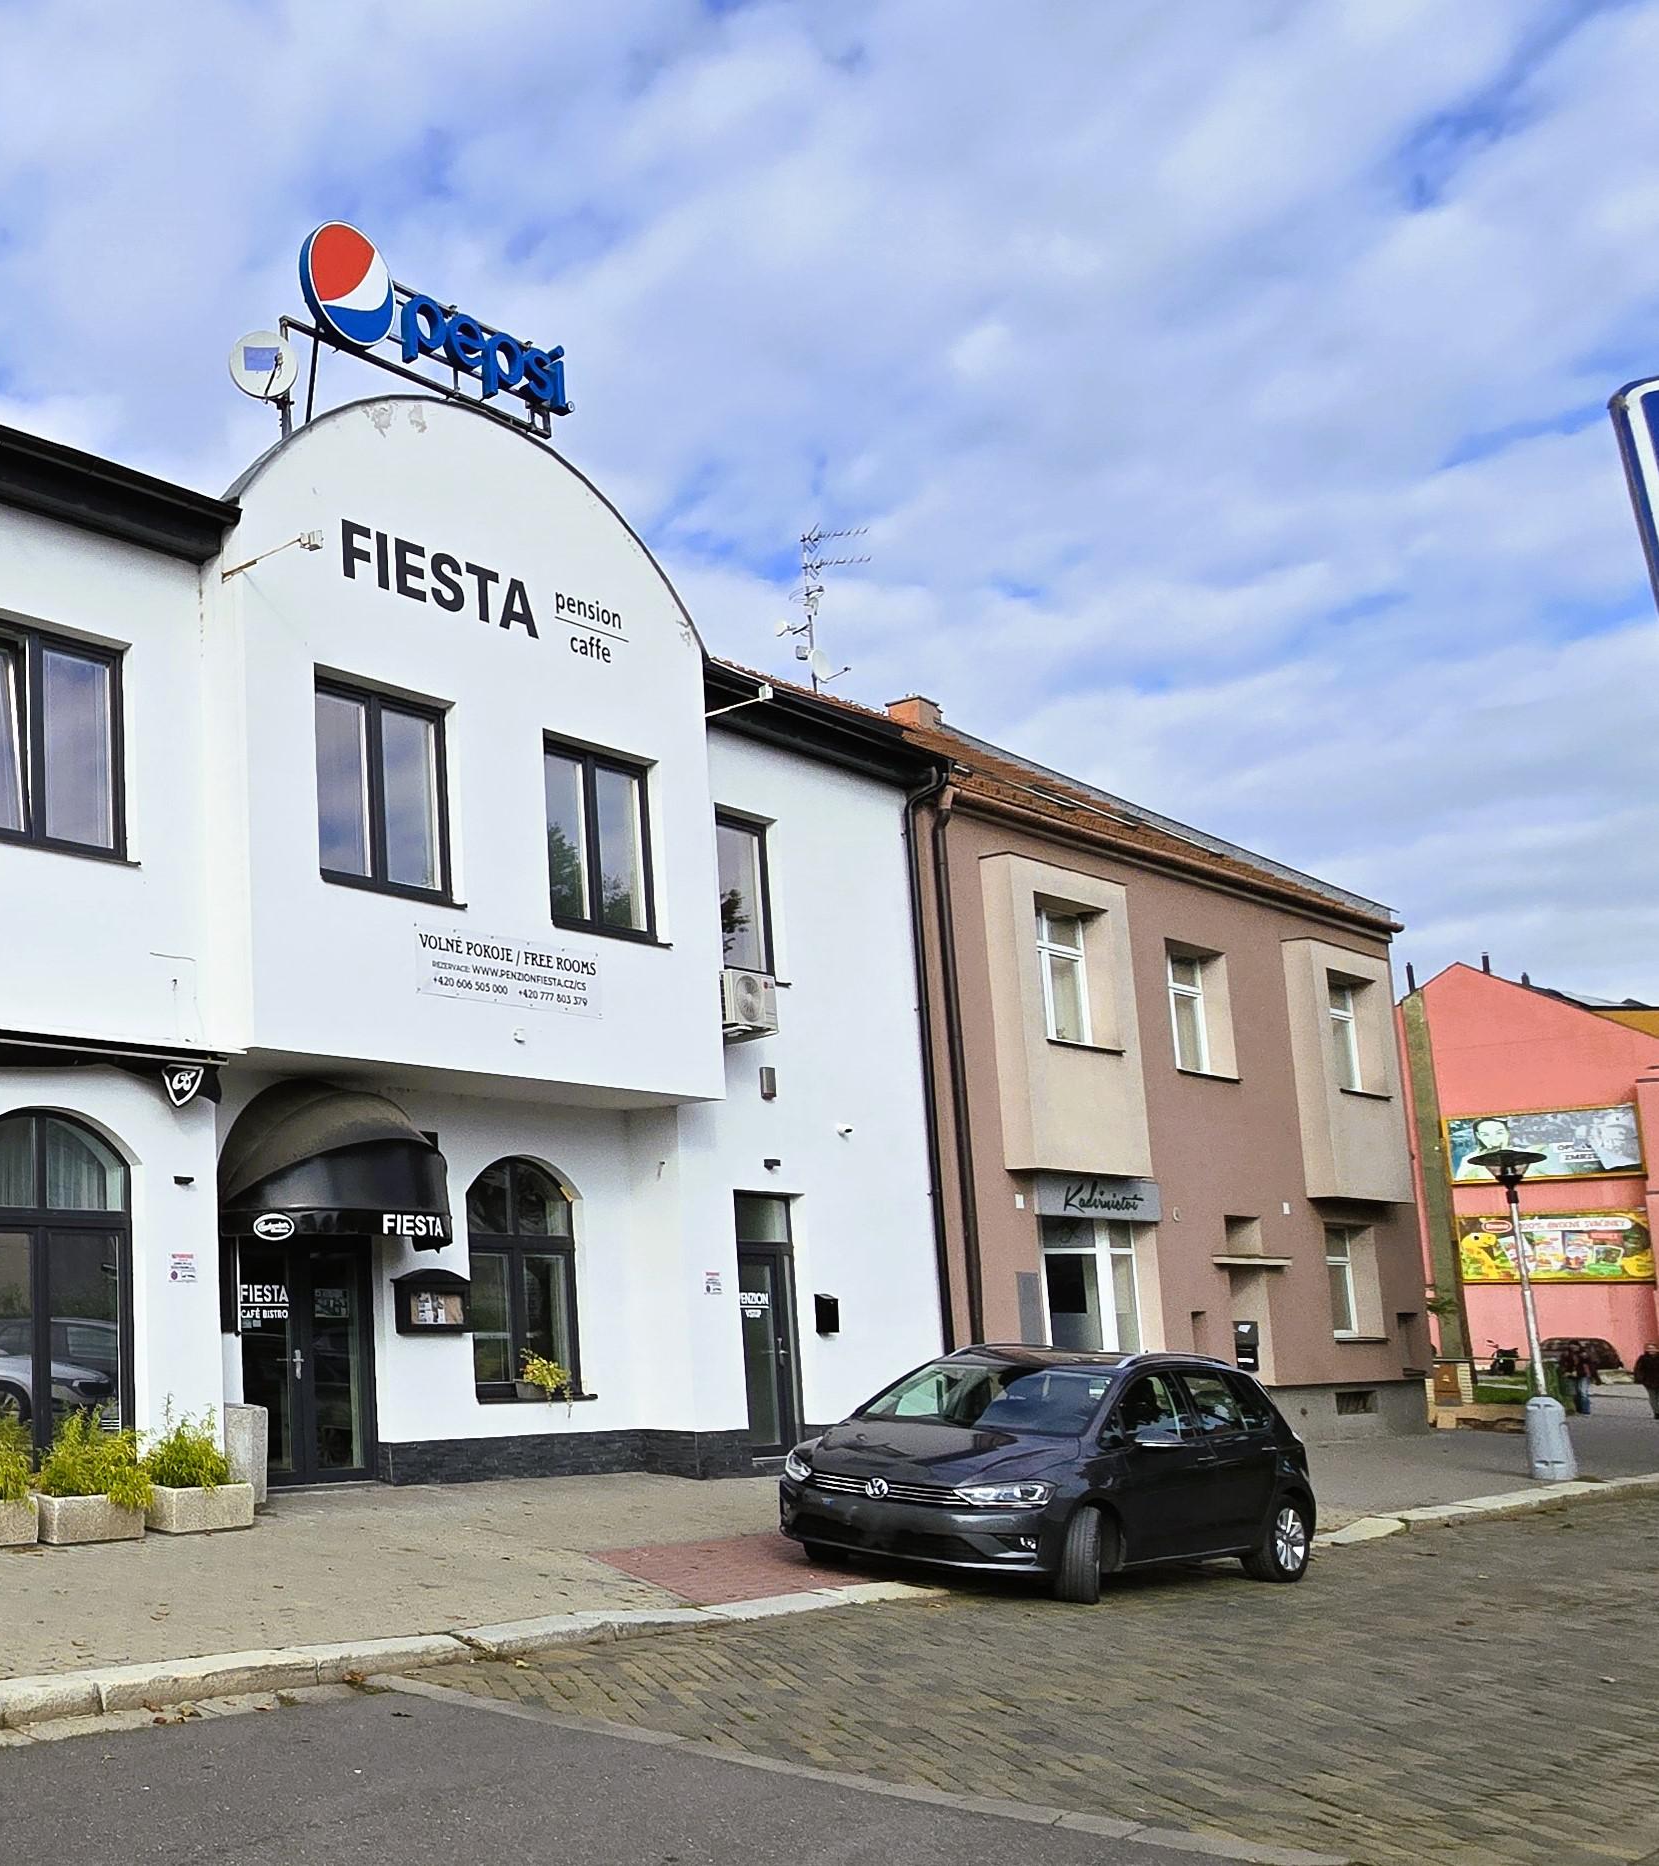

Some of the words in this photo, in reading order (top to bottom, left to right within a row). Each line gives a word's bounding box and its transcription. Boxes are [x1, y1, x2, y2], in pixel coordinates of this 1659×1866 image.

[400, 294, 569, 417] pepsi
[341, 518, 540, 640] FIESTA
[554, 590, 623, 630] pension
[569, 635, 613, 664] caffe
[418, 933, 463, 955] VOLNÉ
[465, 941, 514, 964] POKOJE
[524, 951, 554, 970] FREE
[556, 958, 598, 977] ROOMS
[433, 975, 455, 988] +420
[456, 979, 473, 991] 606
[475, 981, 491, 993] 505
[492, 983, 509, 996] 000
[518, 988, 539, 1001] +420
[540, 991, 555, 1002] 777
[471, 964, 587, 992] WWW.PENZIONFIESTA.CZ/CS
[382, 1213, 444, 1238] FIESTA
[240, 1284, 289, 1303] FIESTA
[739, 1291, 769, 1305] ENZION
[241, 1307, 261, 1319] CAFÉ
[262, 1309, 289, 1319] BISTRO
